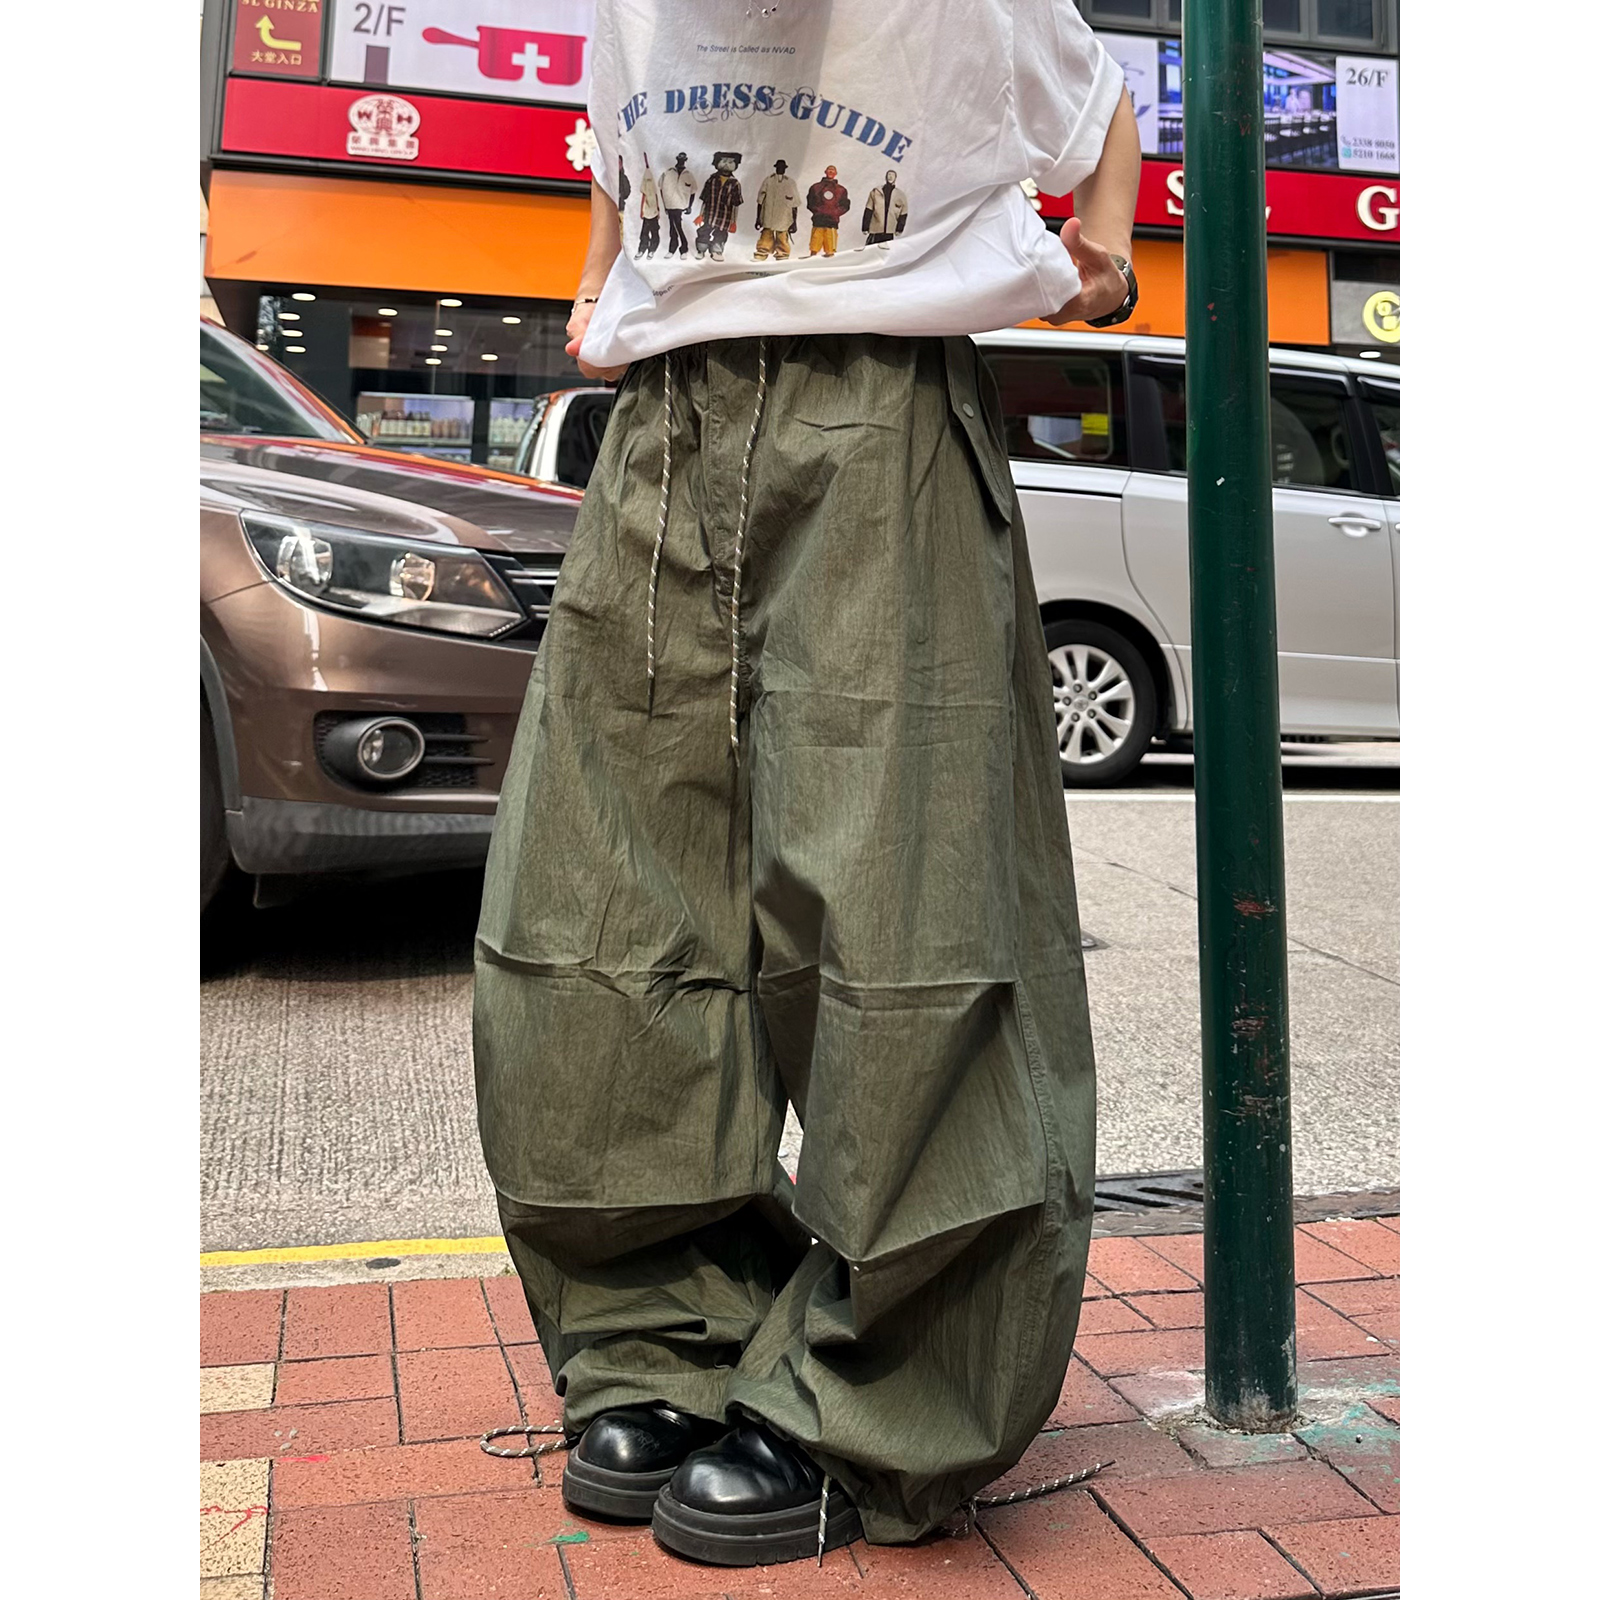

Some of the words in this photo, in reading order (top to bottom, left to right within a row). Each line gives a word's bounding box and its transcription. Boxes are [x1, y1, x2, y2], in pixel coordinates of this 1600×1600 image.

[264, 0, 318, 13] GINZA
[353, 2, 406, 36] 2/F
[251, 49, 302, 66] 大堂入口
[696, 44, 708, 53] The
[709, 44, 730, 53] Street
[730, 45, 737, 53] is
[738, 45, 760, 54] Called
[771, 46, 796, 54] NVAD
[1346, 66, 1388, 88] 26/F
[617, 91, 648, 138] HE
[664, 83, 776, 114] DRESS
[789, 92, 912, 163] GUIDE
